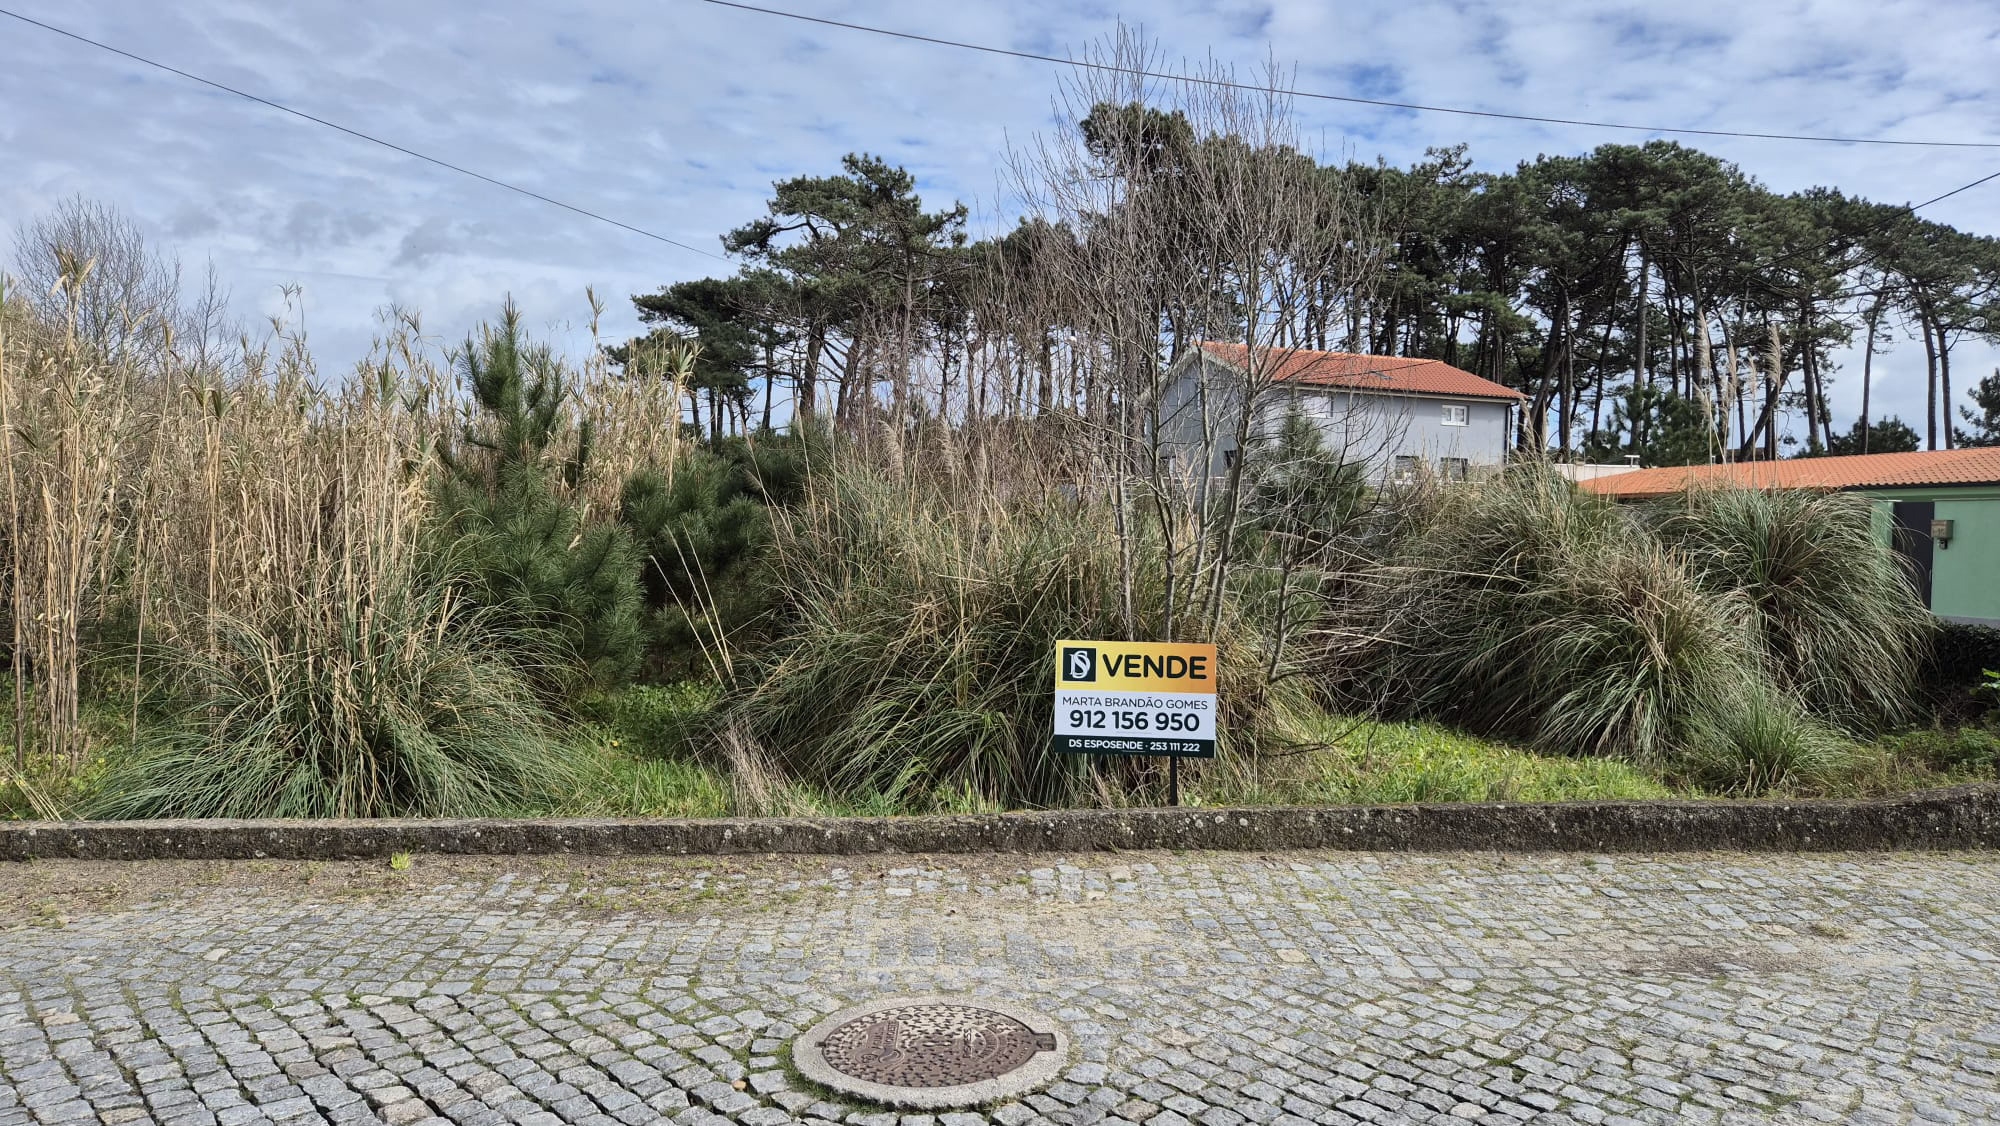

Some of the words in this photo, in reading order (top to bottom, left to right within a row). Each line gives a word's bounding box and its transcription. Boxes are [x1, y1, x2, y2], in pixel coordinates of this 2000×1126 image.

[1102, 653, 1208, 680] VENDE
[1062, 696, 1102, 707] MARTA
[1105, 696, 1163, 708] BRANDÃO
[1166, 699, 1208, 710] GOMES
[1069, 709, 1106, 729] 912
[1111, 710, 1149, 730] 156
[1155, 712, 1200, 732] 950
[1068, 738, 1082, 748] DS
[1084, 739, 1143, 750] ESPOSENDE
[1150, 741, 1168, 751] 253
[1169, 742, 1181, 751] 111
[1182, 743, 1200, 752] 222
